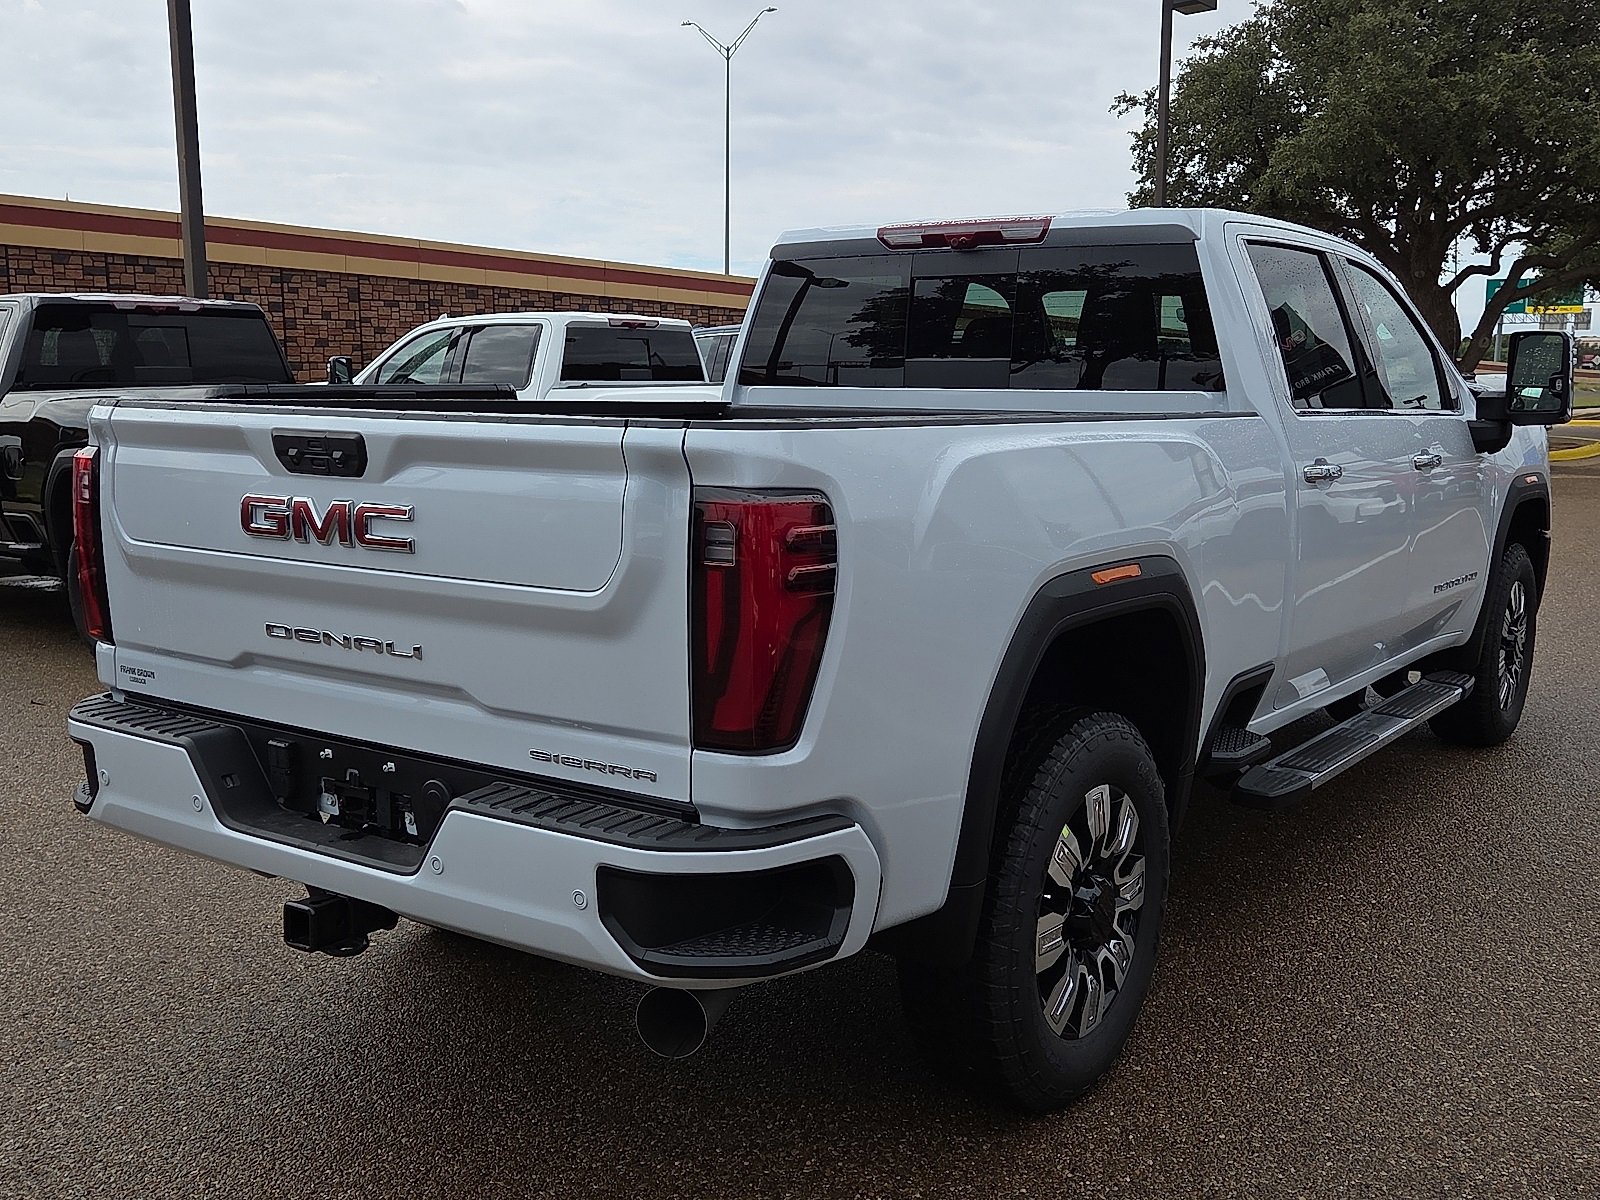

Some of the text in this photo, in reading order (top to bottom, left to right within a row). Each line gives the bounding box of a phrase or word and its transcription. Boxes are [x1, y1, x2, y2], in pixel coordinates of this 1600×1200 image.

[240, 492, 416, 554] GMC
[264, 621, 423, 661] DENALI
[119, 664, 137, 676] FRANK
[529, 749, 657, 783] SIERRA
